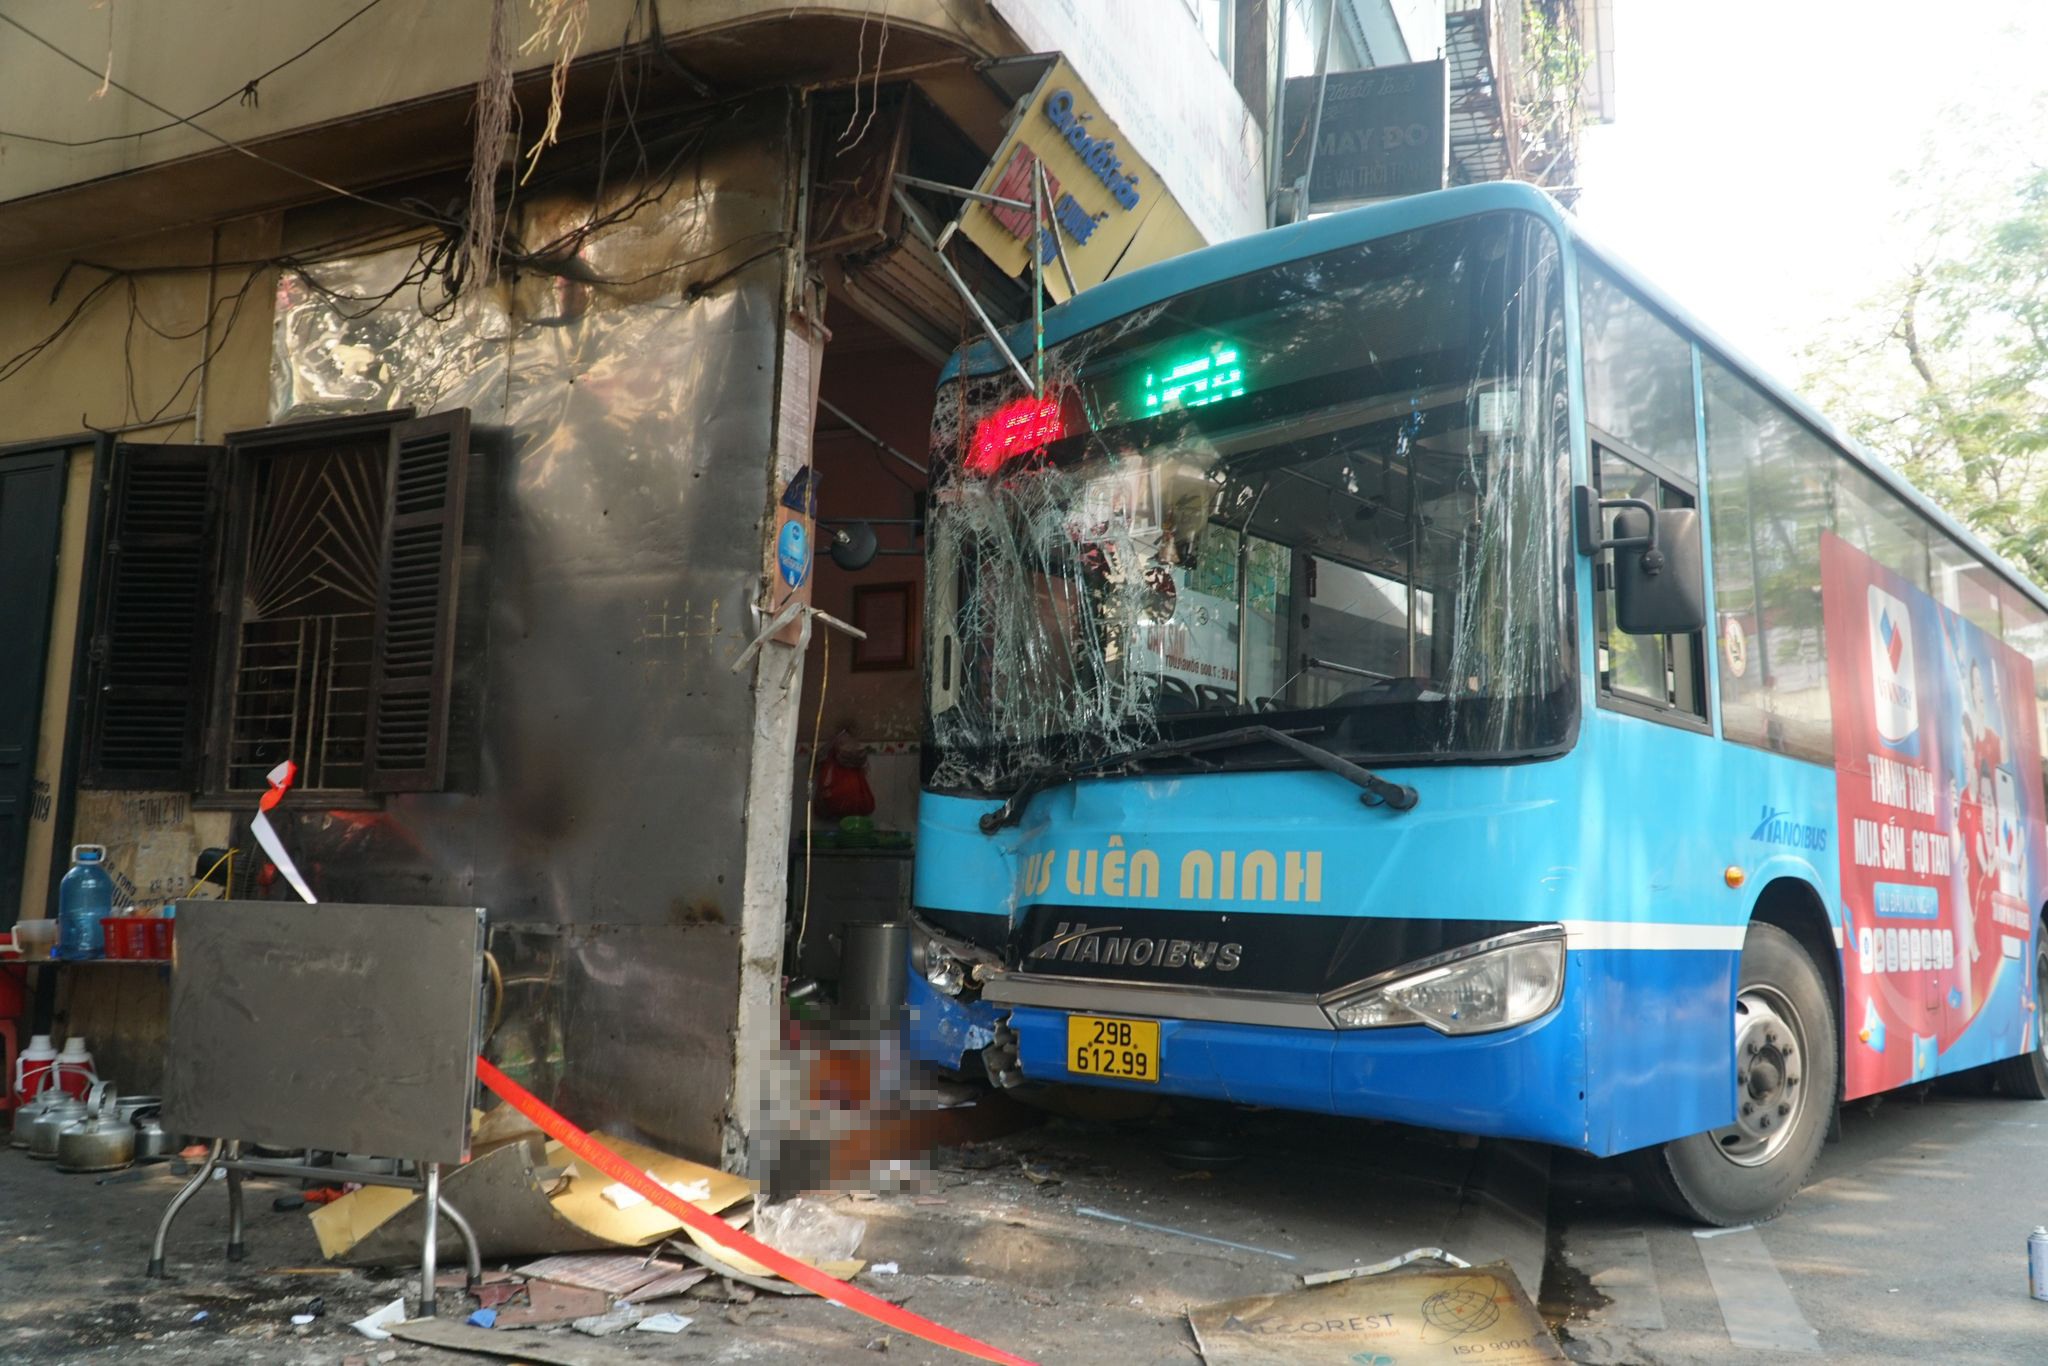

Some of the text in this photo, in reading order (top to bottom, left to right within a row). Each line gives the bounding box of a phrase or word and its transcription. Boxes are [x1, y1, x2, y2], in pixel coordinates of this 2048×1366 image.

[1317, 128, 1374, 156] MAY
[1867, 753, 1935, 816] THANH TOÁN
[1750, 805, 1827, 851] HANOIBUS
[1854, 818, 1881, 867] MUA
[1881, 815, 1906, 871] SẮM
[1929, 833, 1951, 876] TAXI
[1023, 835, 1323, 902] US LIÊN NINH
[1029, 921, 1243, 972] HANOIBUS
[1093, 1021, 1132, 1047] 29B
[1077, 1046, 1147, 1076] 612.99
[1452, 1338, 1531, 1357] ISO 9001
